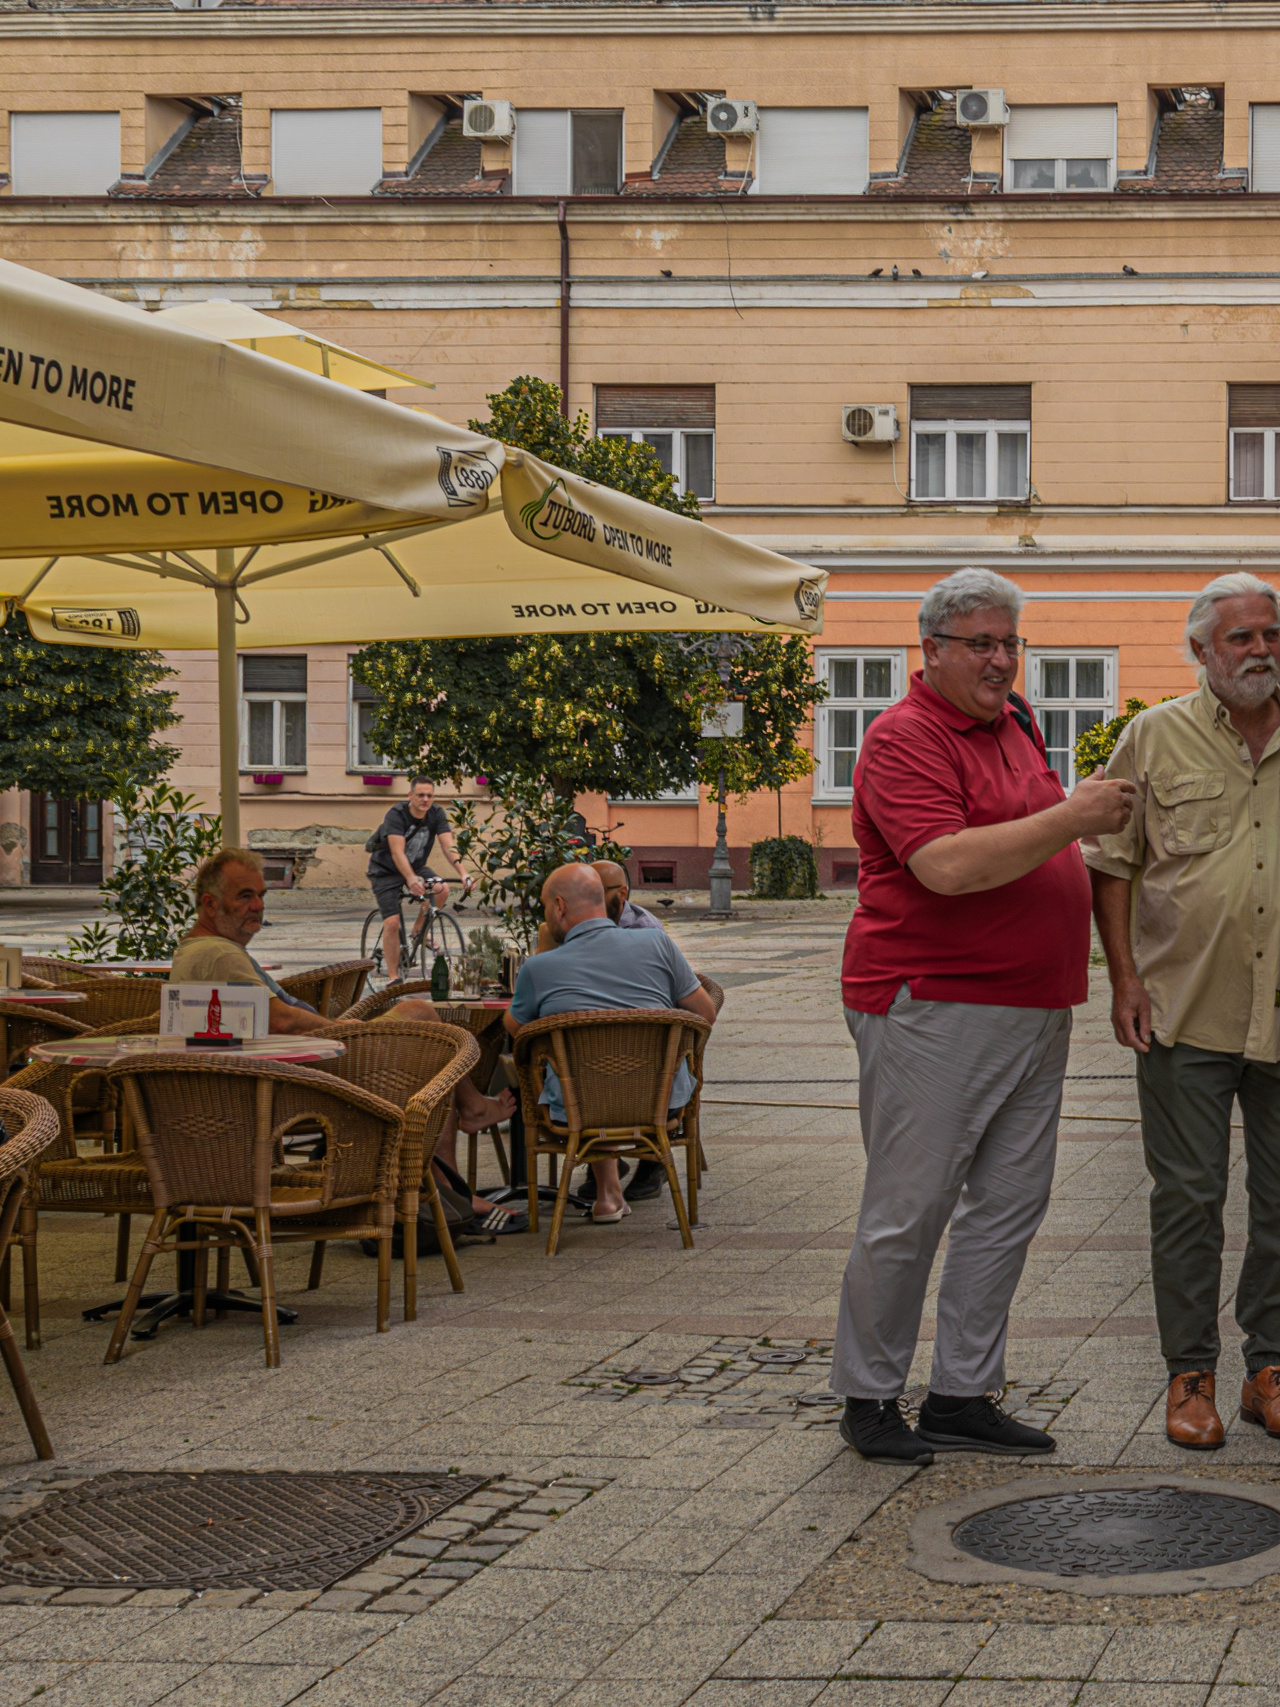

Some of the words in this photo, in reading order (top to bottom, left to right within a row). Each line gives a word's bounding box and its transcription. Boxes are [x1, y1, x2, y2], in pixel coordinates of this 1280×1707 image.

[30, 354, 63, 394] TO
[67, 365, 137, 412] MORE
[539, 498, 597, 543] TUBORG
[602, 523, 630, 553] OPEN
[630, 533, 644, 557] TO
[645, 539, 673, 567] MORE
